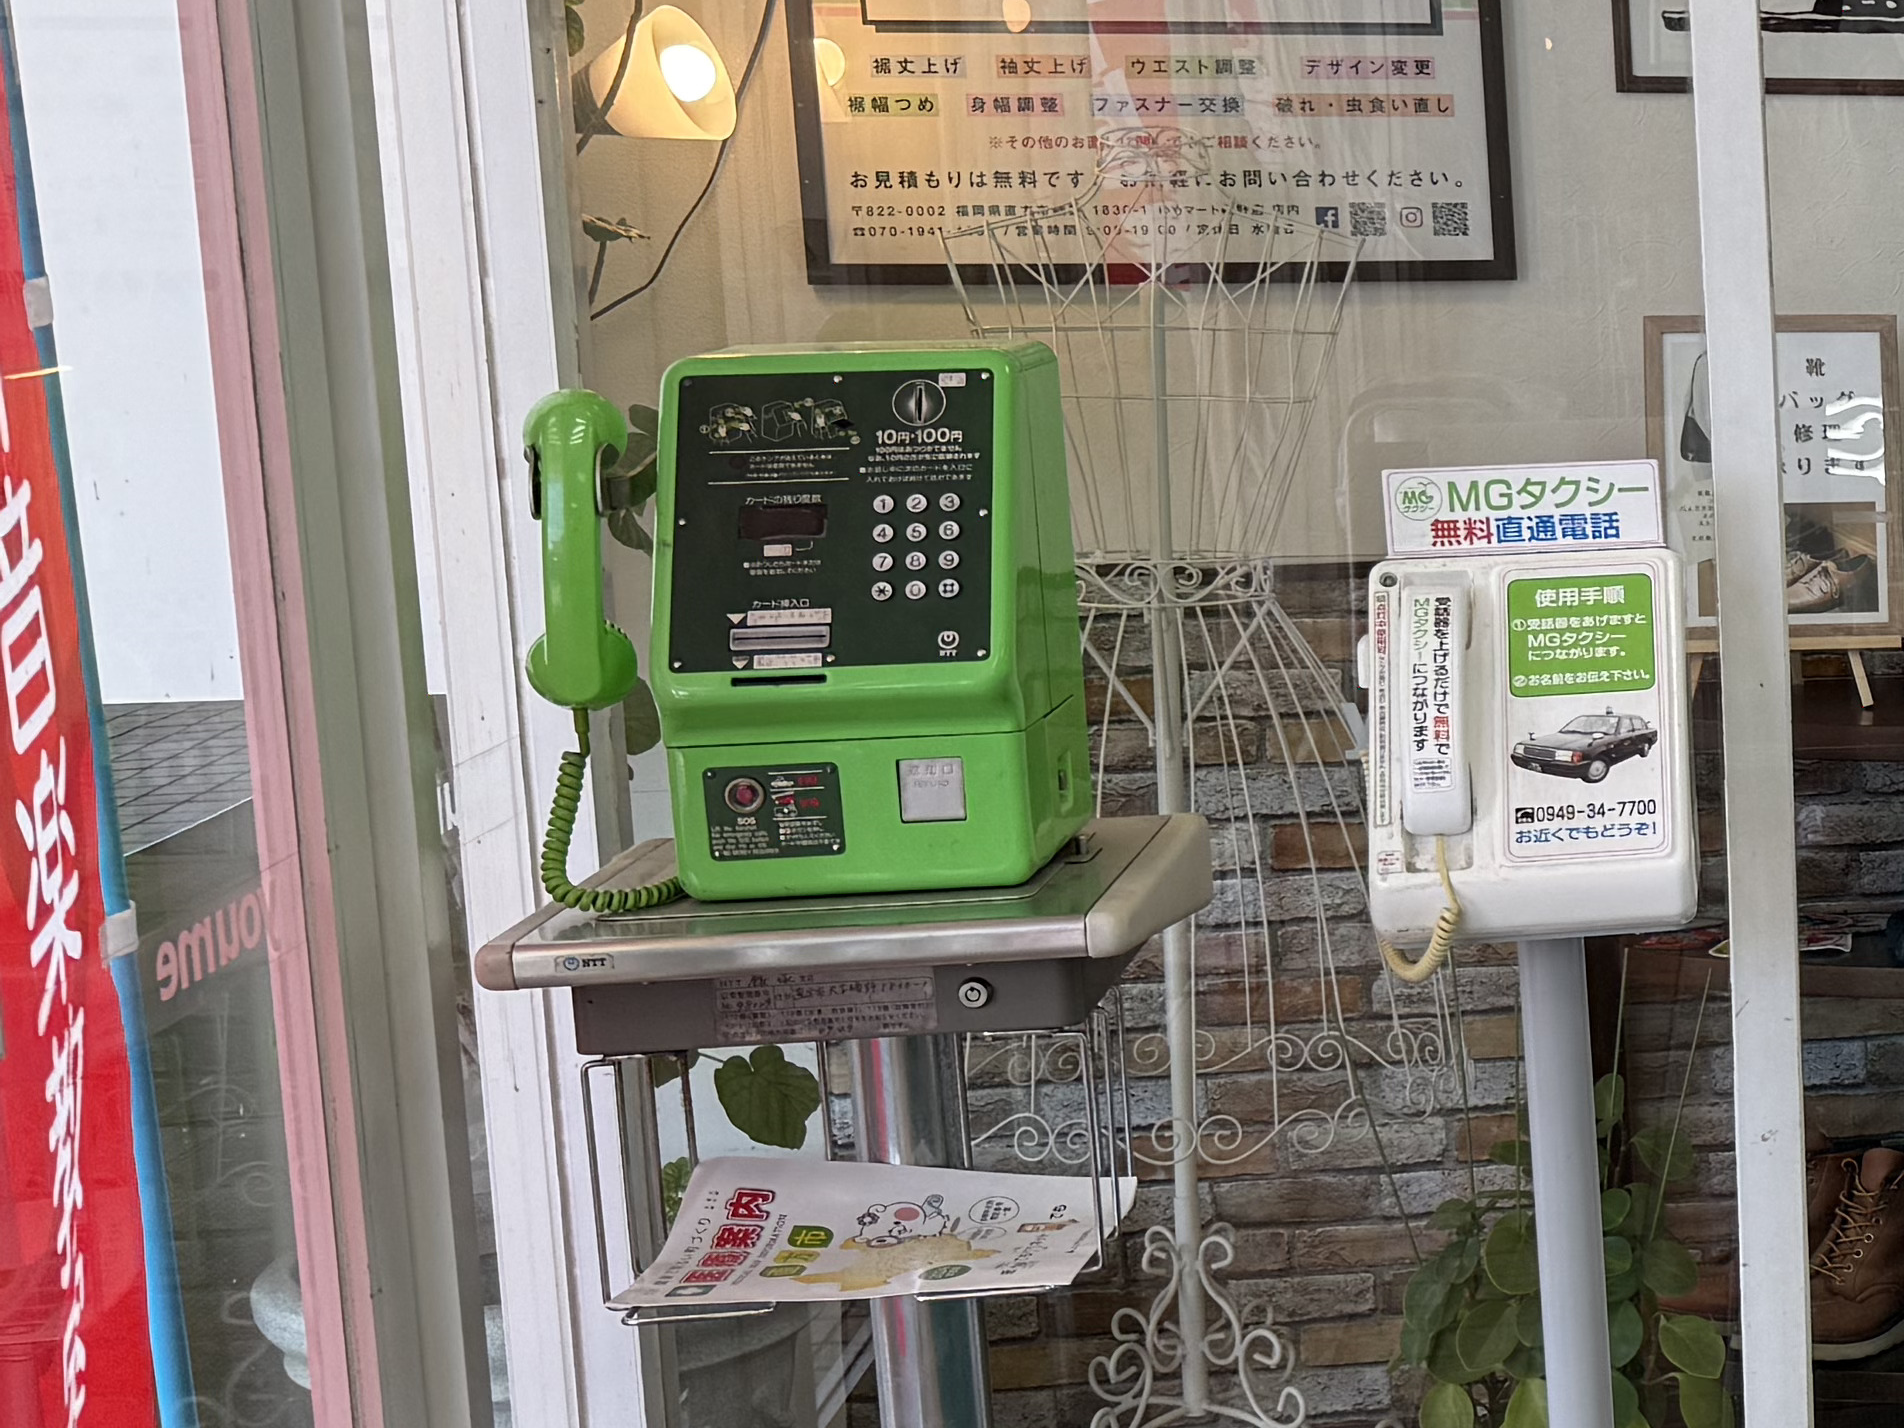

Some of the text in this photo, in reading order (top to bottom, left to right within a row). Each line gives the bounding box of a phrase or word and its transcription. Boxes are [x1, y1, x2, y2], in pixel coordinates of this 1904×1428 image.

[871, 56, 962, 77] 裾丈上げ
[999, 56, 1089, 77] 袖丈上げ
[1129, 56, 1260, 77] ウエスト調整
[1303, 57, 1435, 78] デザイン変更
[846, 95, 937, 115] 裾幅つめ
[969, 94, 1063, 115] 身幅調整
[1092, 94, 1244, 115] ファスナー交換
[1275, 95, 1454, 115] 破れ・虫食い直し
[1805, 357, 1826, 378] 靴
[1447, 476, 1650, 513] MGタクシー
[1431, 512, 1622, 547] 無料直通電話
[1534, 584, 1626, 608] 使用手順
[1527, 632, 1627, 648] MGタクシー
[1527, 648, 1626, 662] につながります。
[1536, 798, 1657, 822] 0949-34-7700
